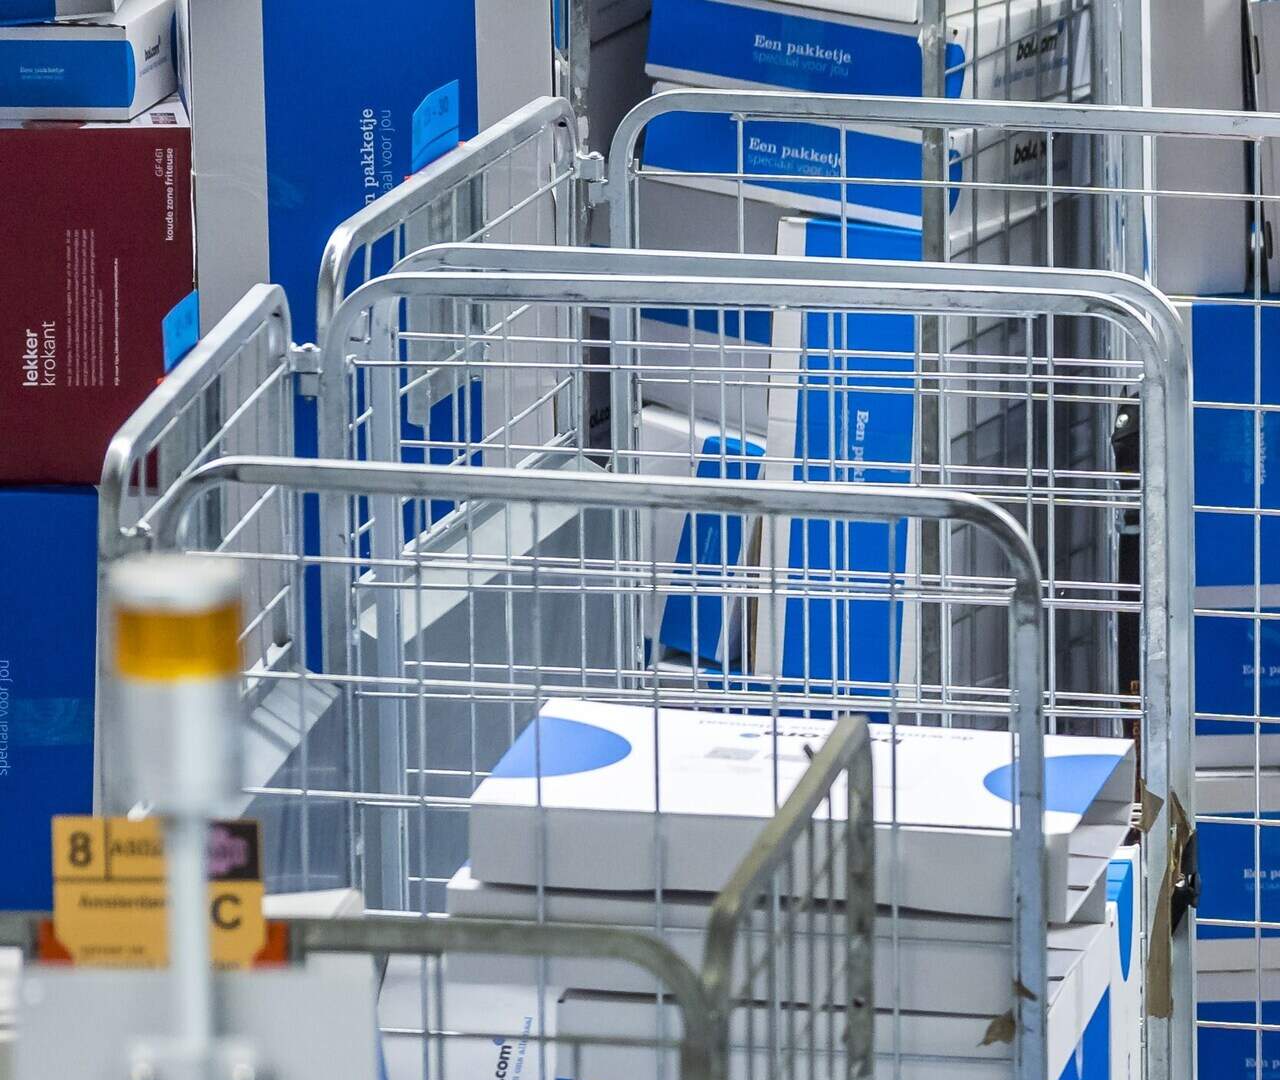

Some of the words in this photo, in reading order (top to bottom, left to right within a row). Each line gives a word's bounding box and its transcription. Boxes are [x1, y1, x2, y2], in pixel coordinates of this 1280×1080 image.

[754, 34, 782, 51] Een
[787, 44, 852, 65] pakketje
[380, 109, 396, 133] jou
[360, 108, 379, 188] pakketje
[381, 136, 393, 167] voor
[749, 137, 777, 155] Een
[155, 148, 164, 177] GF461
[164, 148, 175, 186] friteuse
[166, 187, 175, 210] zone
[165, 211, 175, 241] koude
[22, 329, 39, 387] lekker
[39, 321, 56, 387] krokant
[857, 409, 870, 441] Een
[70, 831, 92, 868] 8
[211, 894, 242, 931] C
[514, 1057, 525, 1074] ons
